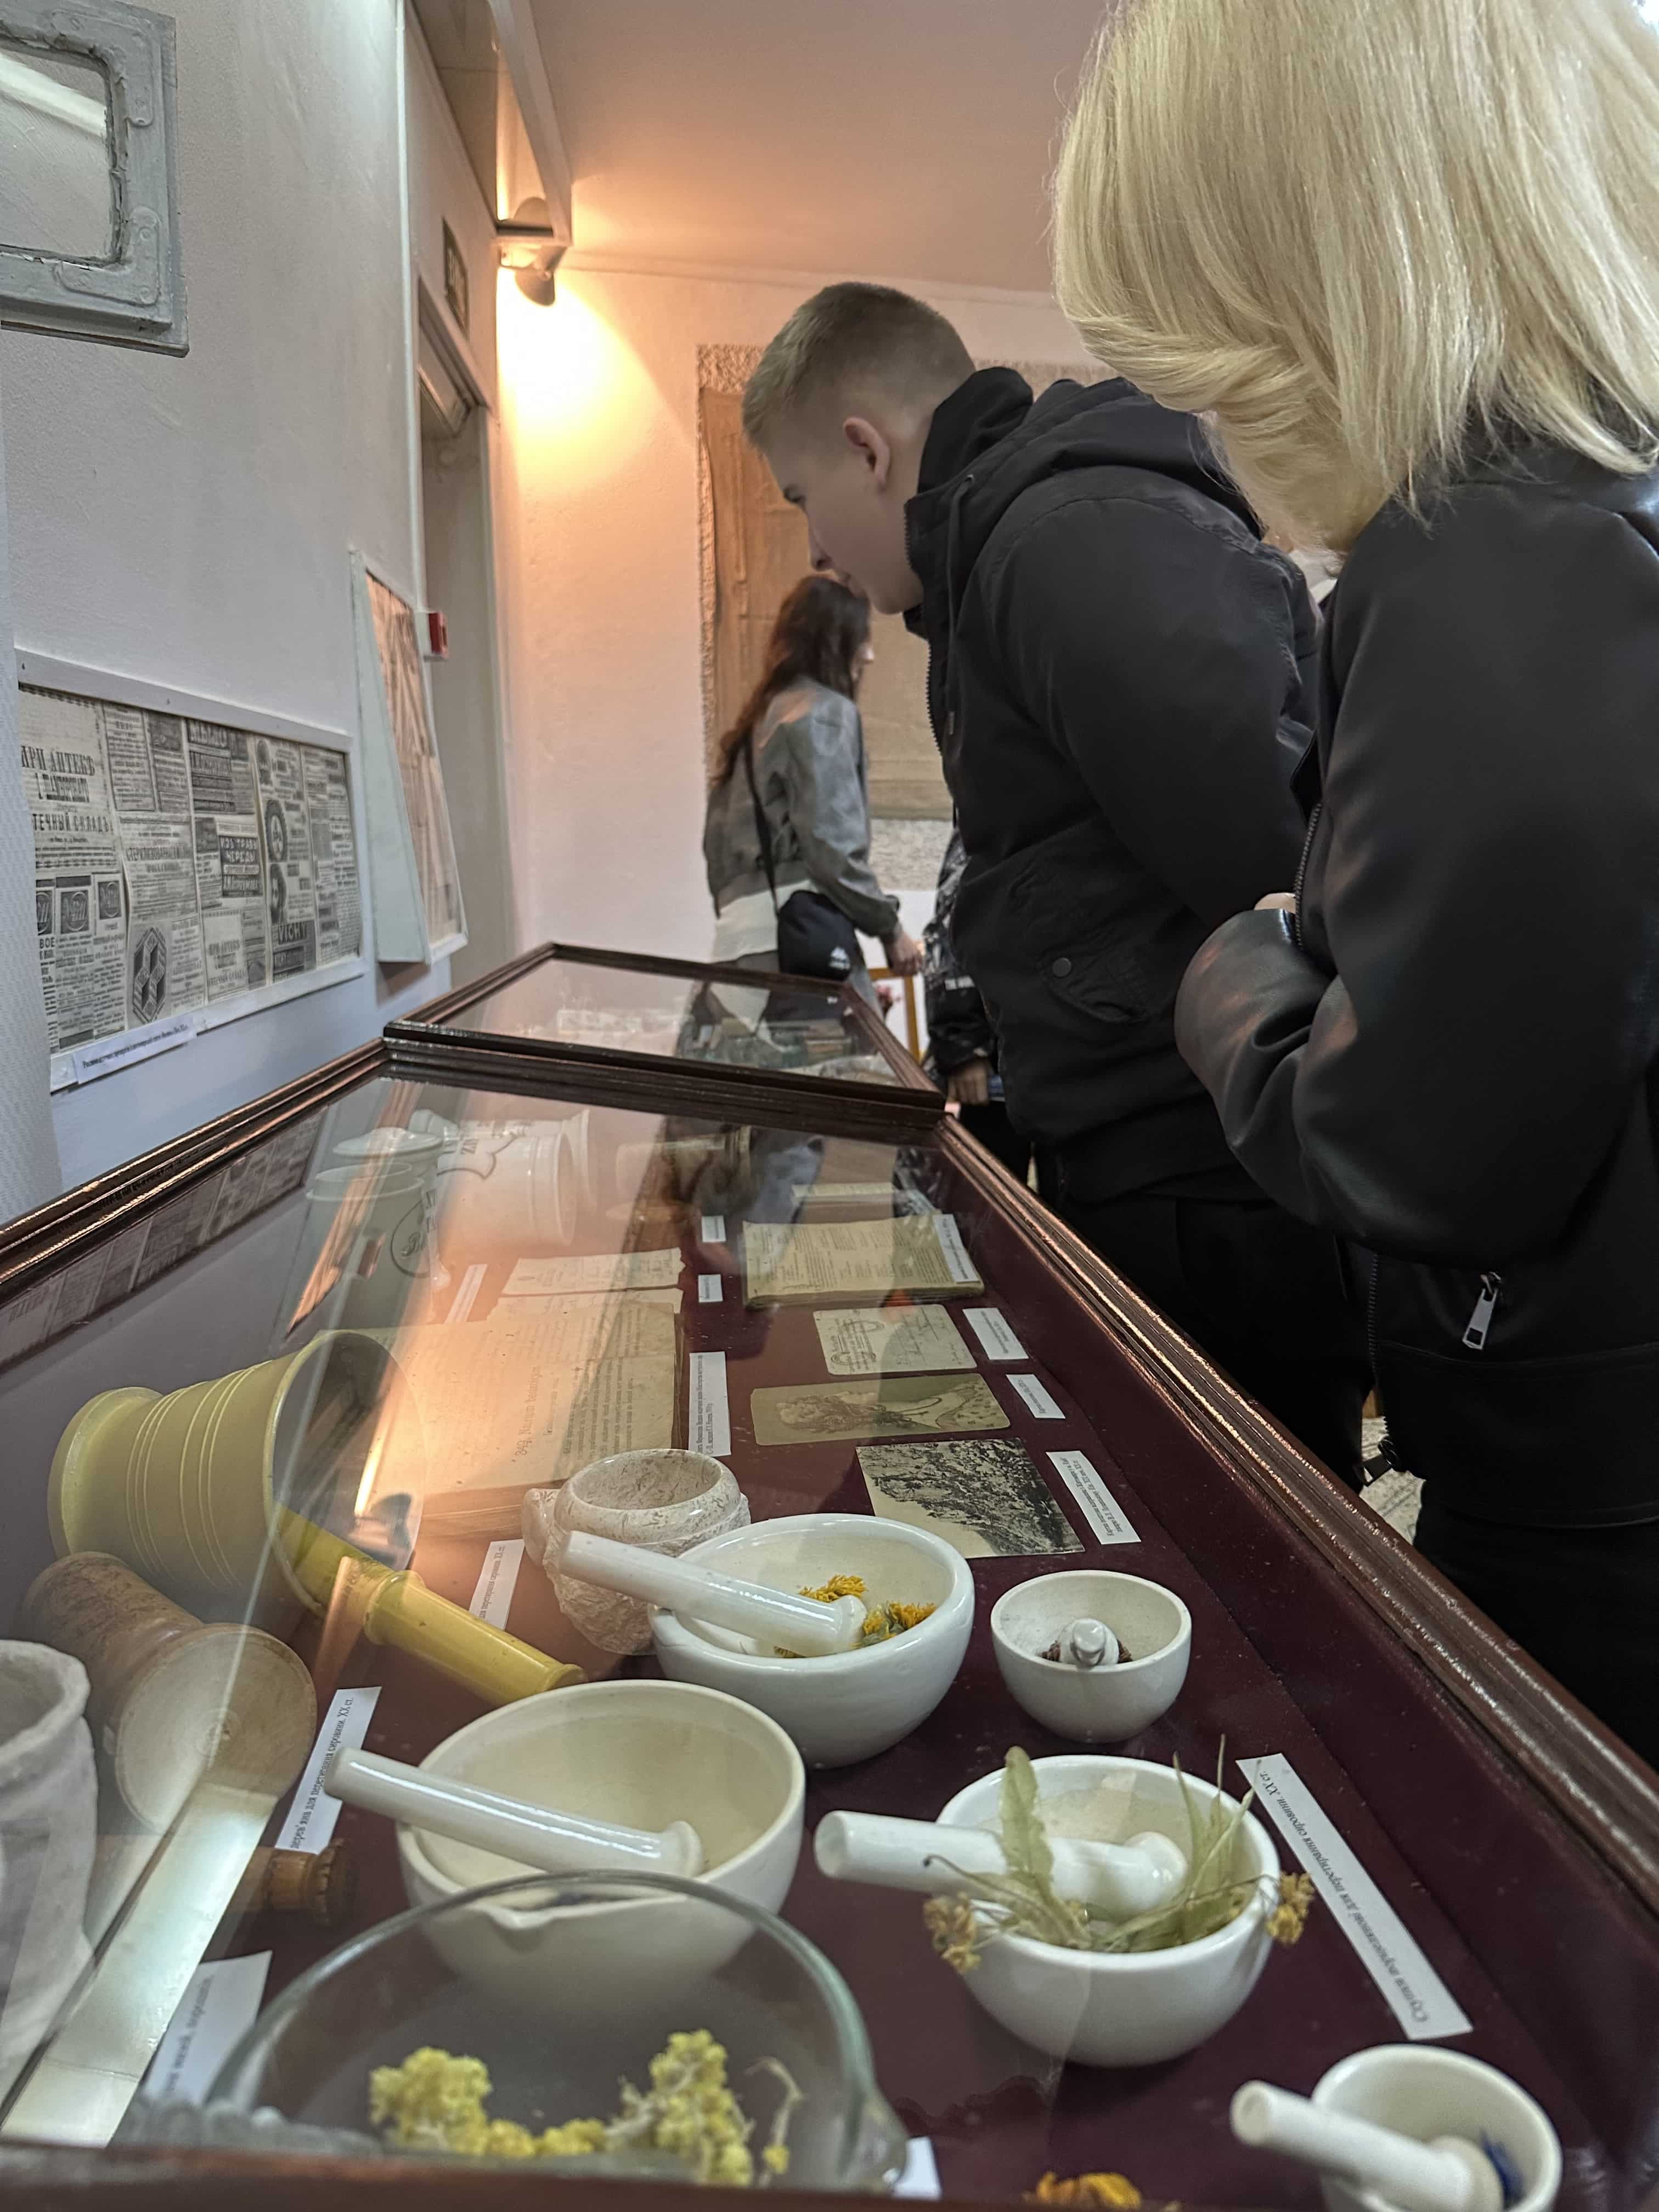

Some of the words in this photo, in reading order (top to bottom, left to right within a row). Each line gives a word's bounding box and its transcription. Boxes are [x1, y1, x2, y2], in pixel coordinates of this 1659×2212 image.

[1262, 1781, 1279, 1796] ХХ
[1277, 1796, 1307, 1836] сировини.
[1304, 1837, 1346, 1892] перетирання
